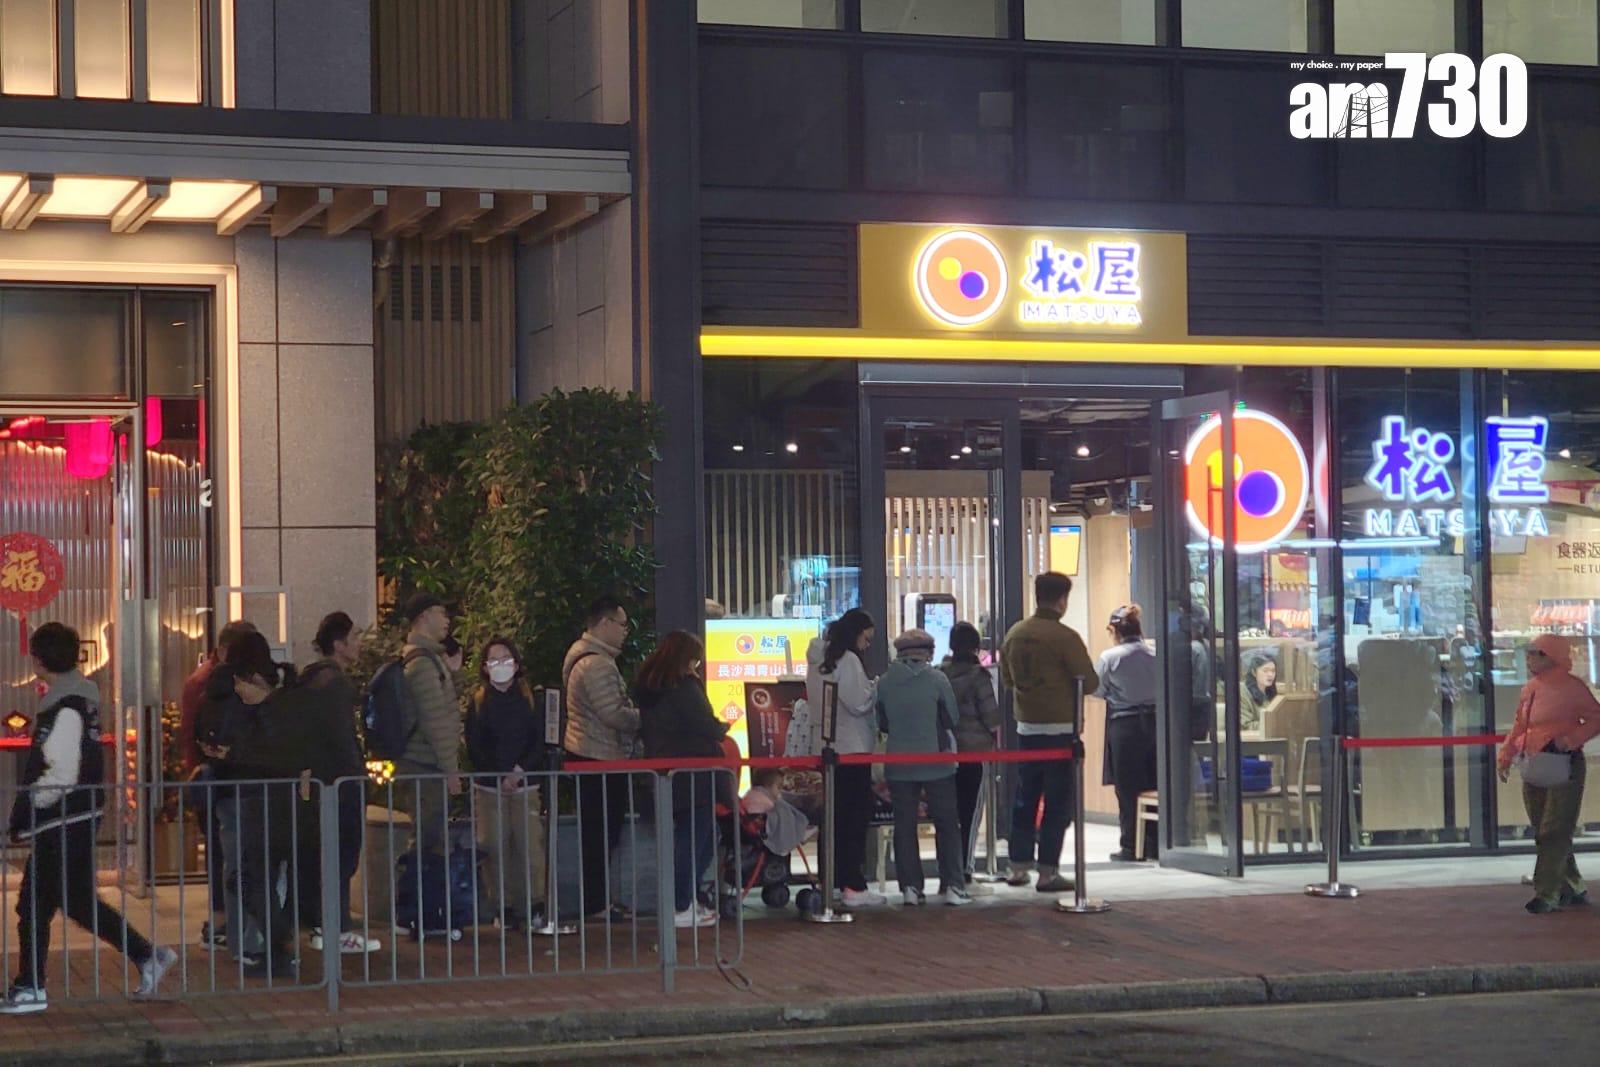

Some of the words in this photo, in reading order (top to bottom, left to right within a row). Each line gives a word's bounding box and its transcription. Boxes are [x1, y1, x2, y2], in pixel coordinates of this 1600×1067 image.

[1024, 240, 1141, 298] 松屋
[1021, 302, 1140, 322] MATSUYA
[1366, 416, 1549, 503] 松屋
[1, 550, 46, 592] 福
[760, 635, 787, 648] 松屋
